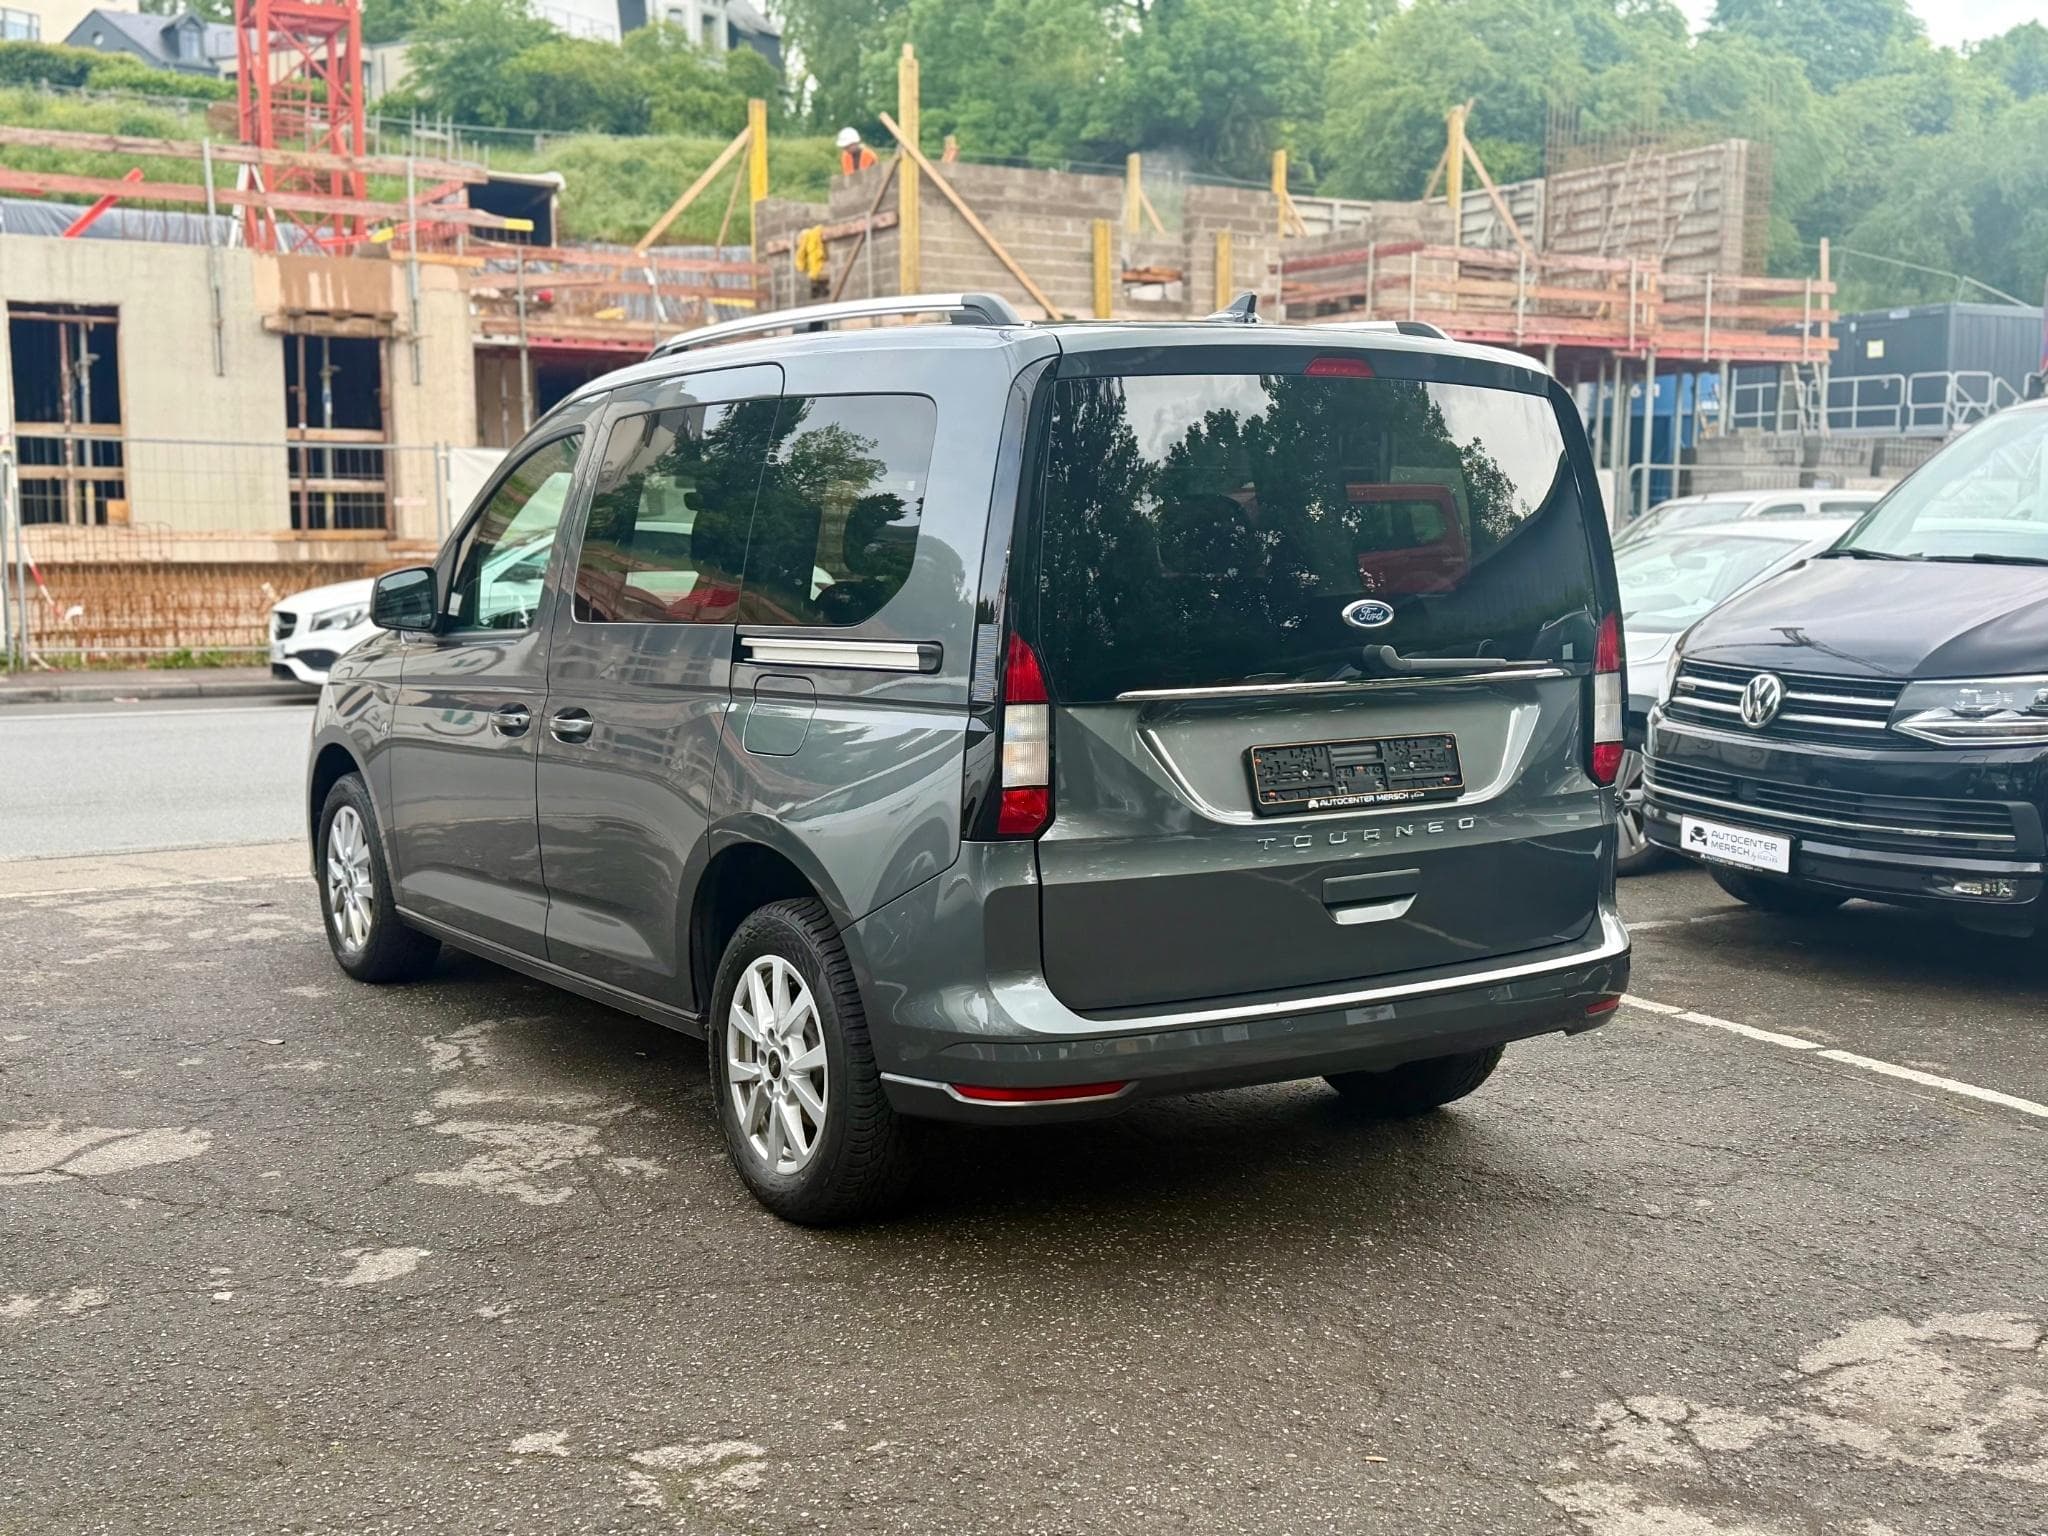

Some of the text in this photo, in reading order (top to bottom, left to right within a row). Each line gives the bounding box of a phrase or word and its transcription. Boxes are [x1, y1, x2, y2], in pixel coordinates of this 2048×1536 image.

[1359, 606, 1384, 621] Ford
[1320, 795, 1375, 807] AUTOCENTER
[1376, 792, 1409, 802] MERSCH
[1257, 817, 1475, 850] TOURNEO
[1711, 830, 1778, 852] AUTOCENTER
[1711, 840, 1750, 856] MERSCH
